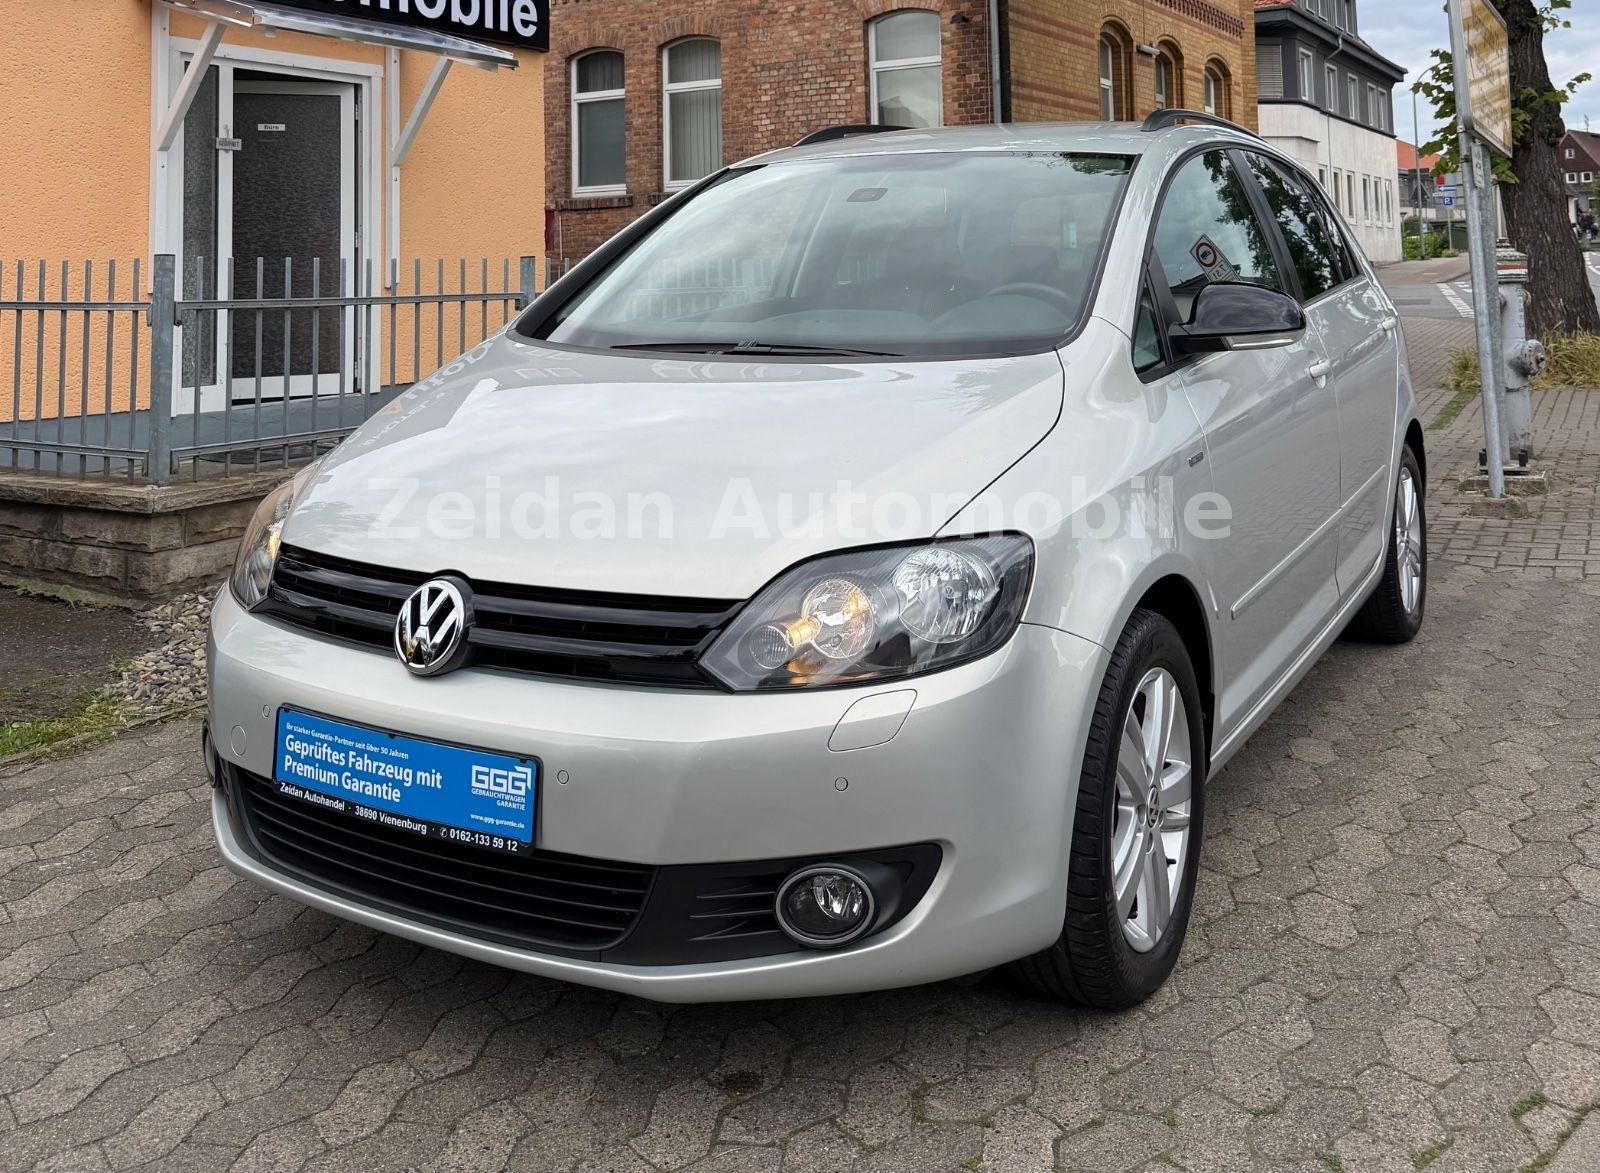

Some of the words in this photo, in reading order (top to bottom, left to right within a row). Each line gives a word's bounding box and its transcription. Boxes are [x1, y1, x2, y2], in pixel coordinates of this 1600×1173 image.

[311, 729, 355, 747] Garantie-Partner
[355, 740, 366, 750] seit
[366, 742, 380, 753] über
[388, 748, 409, 760] Jahren
[285, 734, 346, 766] Geprüftes
[348, 750, 413, 787] Fahrzeug
[416, 768, 442, 789] mit
[284, 754, 339, 786] Premium
[341, 771, 401, 803] Garantie
[471, 764, 526, 796] GGG
[471, 787, 526, 804] GEBRAUCHTWAGEN
[496, 799, 526, 811] GARANTIE
[280, 782, 303, 798] Zeidan
[303, 790, 345, 811] Autohandel
[354, 805, 377, 820] 38690
[378, 812, 427, 835] Vienenburg
[450, 828, 490, 846] 0162-133
[492, 837, 504, 849] 59
[506, 839, 518, 852] 12
[470, 813, 525, 829] www.ggg-garantie.de
